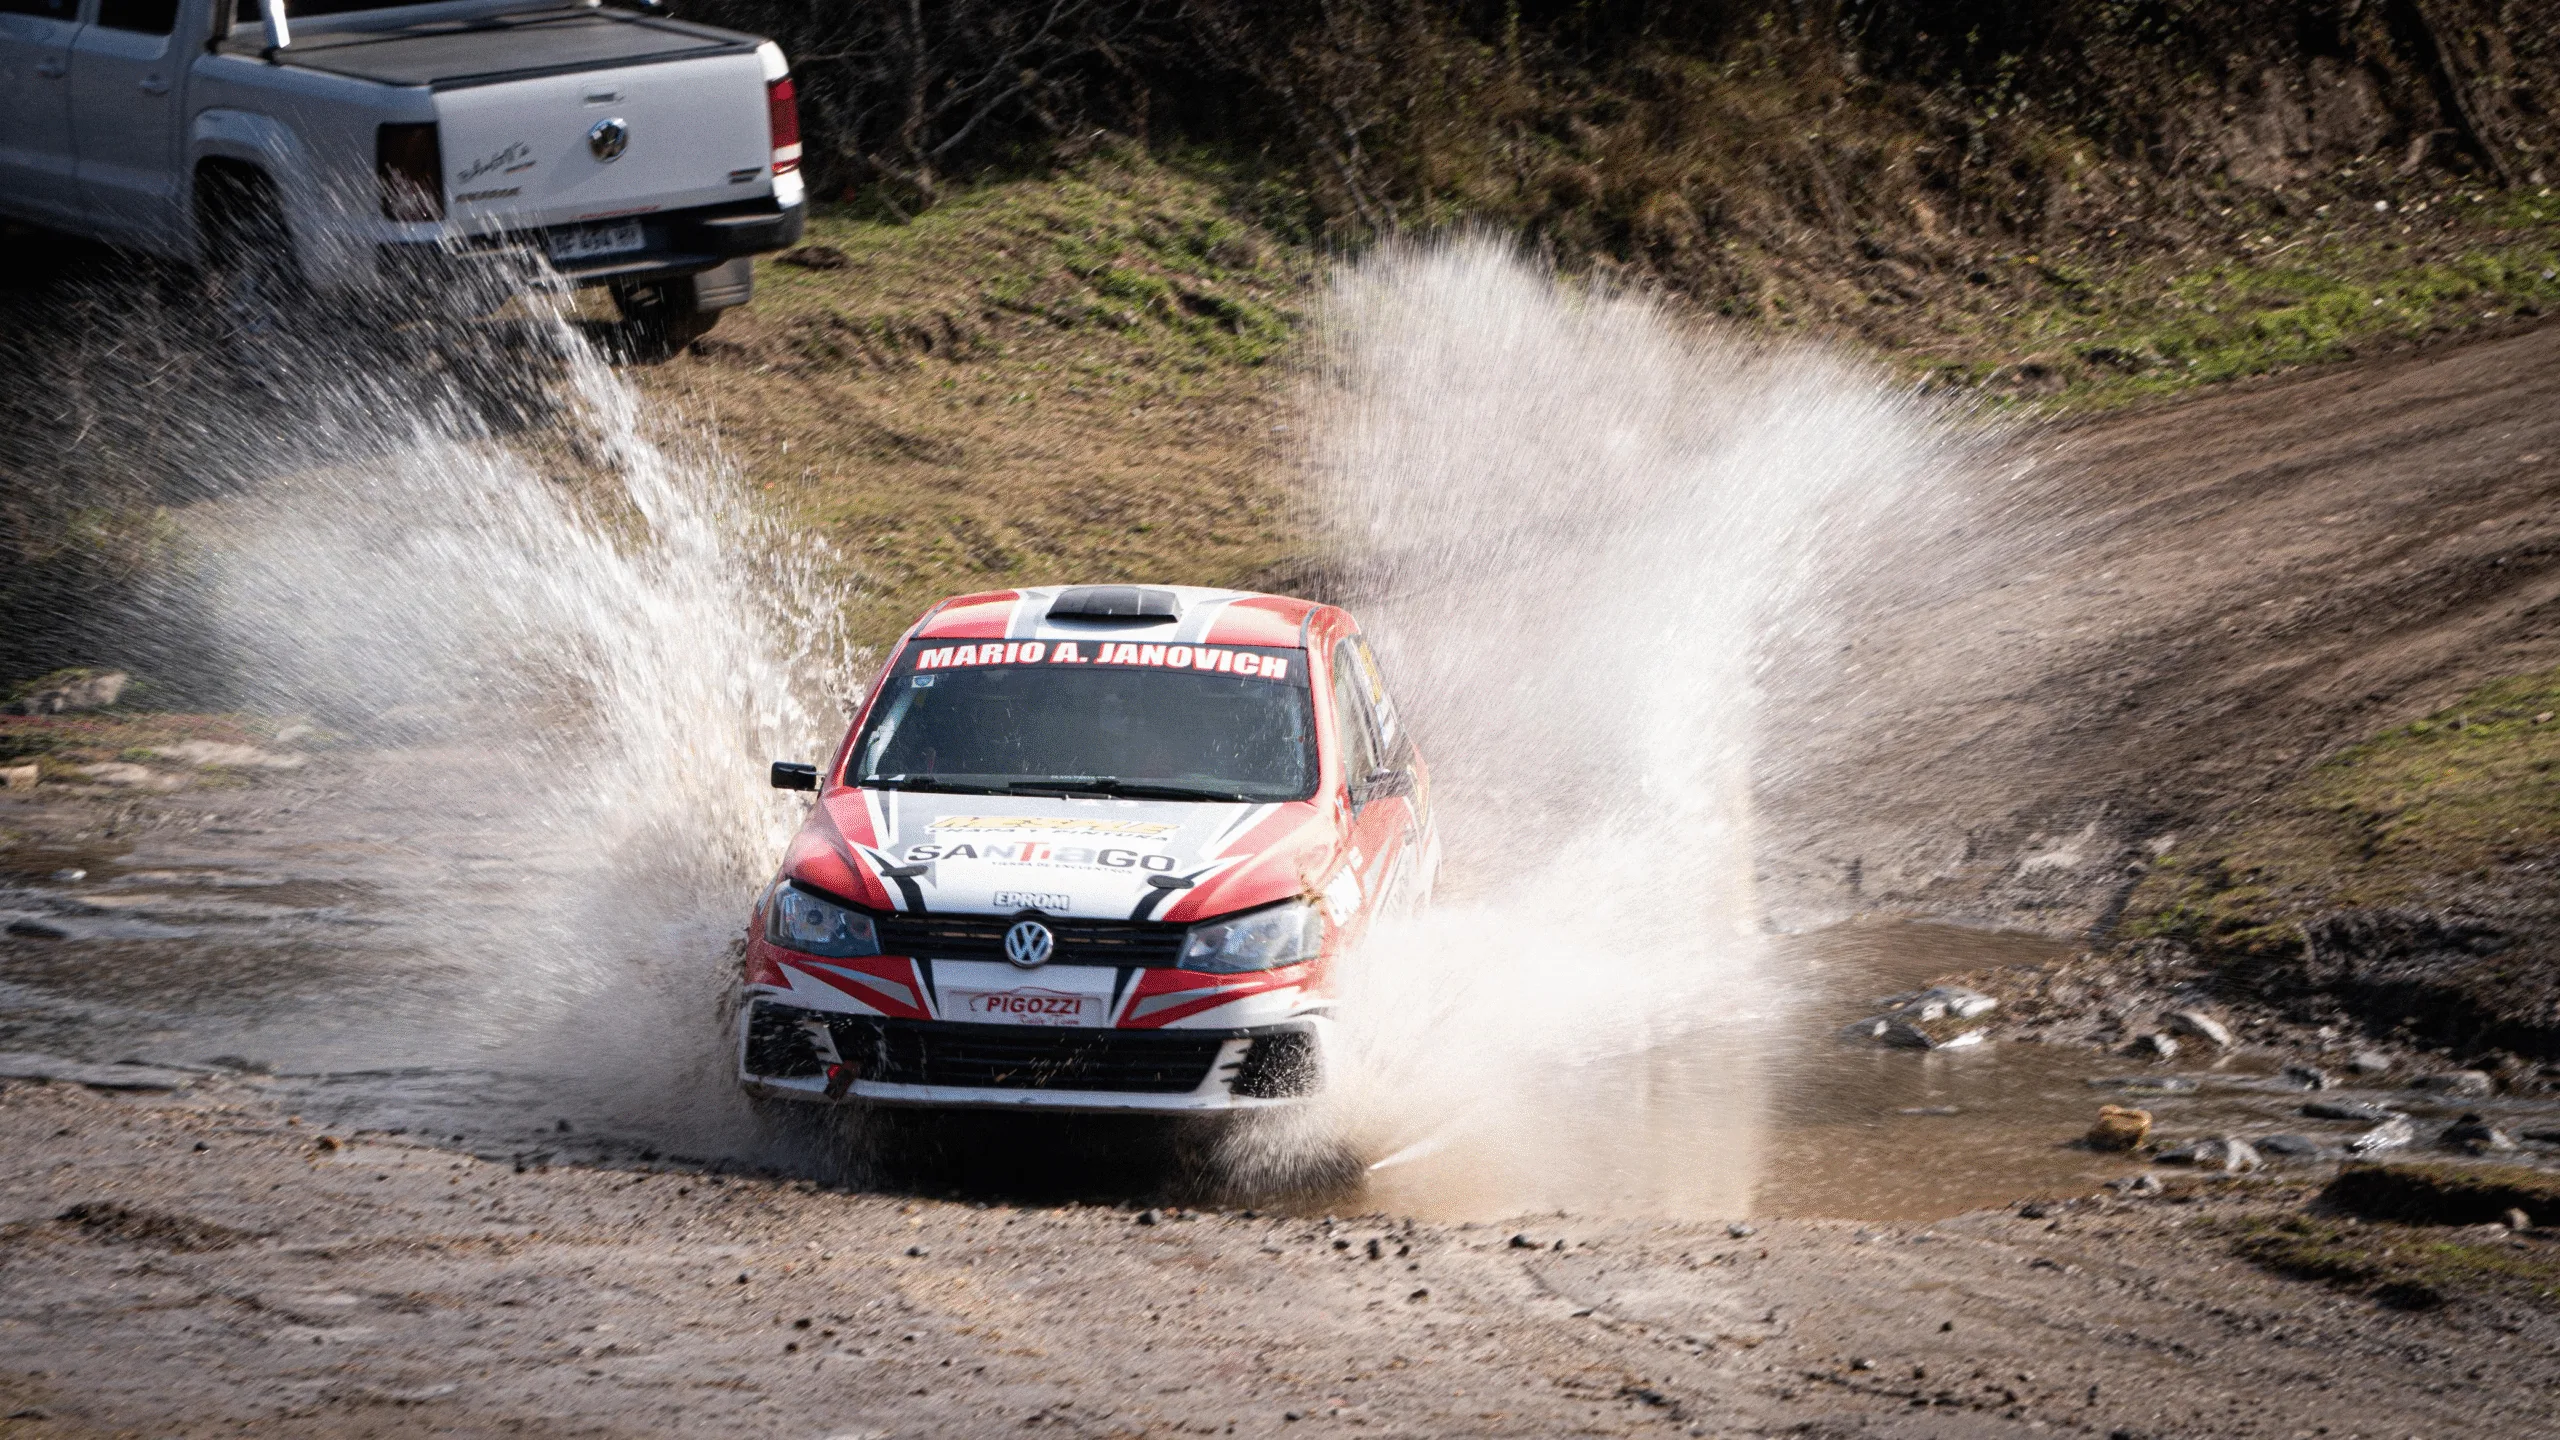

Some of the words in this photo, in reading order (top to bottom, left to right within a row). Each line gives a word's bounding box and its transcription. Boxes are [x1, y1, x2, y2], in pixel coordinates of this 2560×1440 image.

[916, 642, 1043, 670] MARIO
[1049, 642, 1089, 665] A.
[1096, 643, 1289, 680] JANOVICH
[986, 996, 1080, 1015] PIGOZZI
